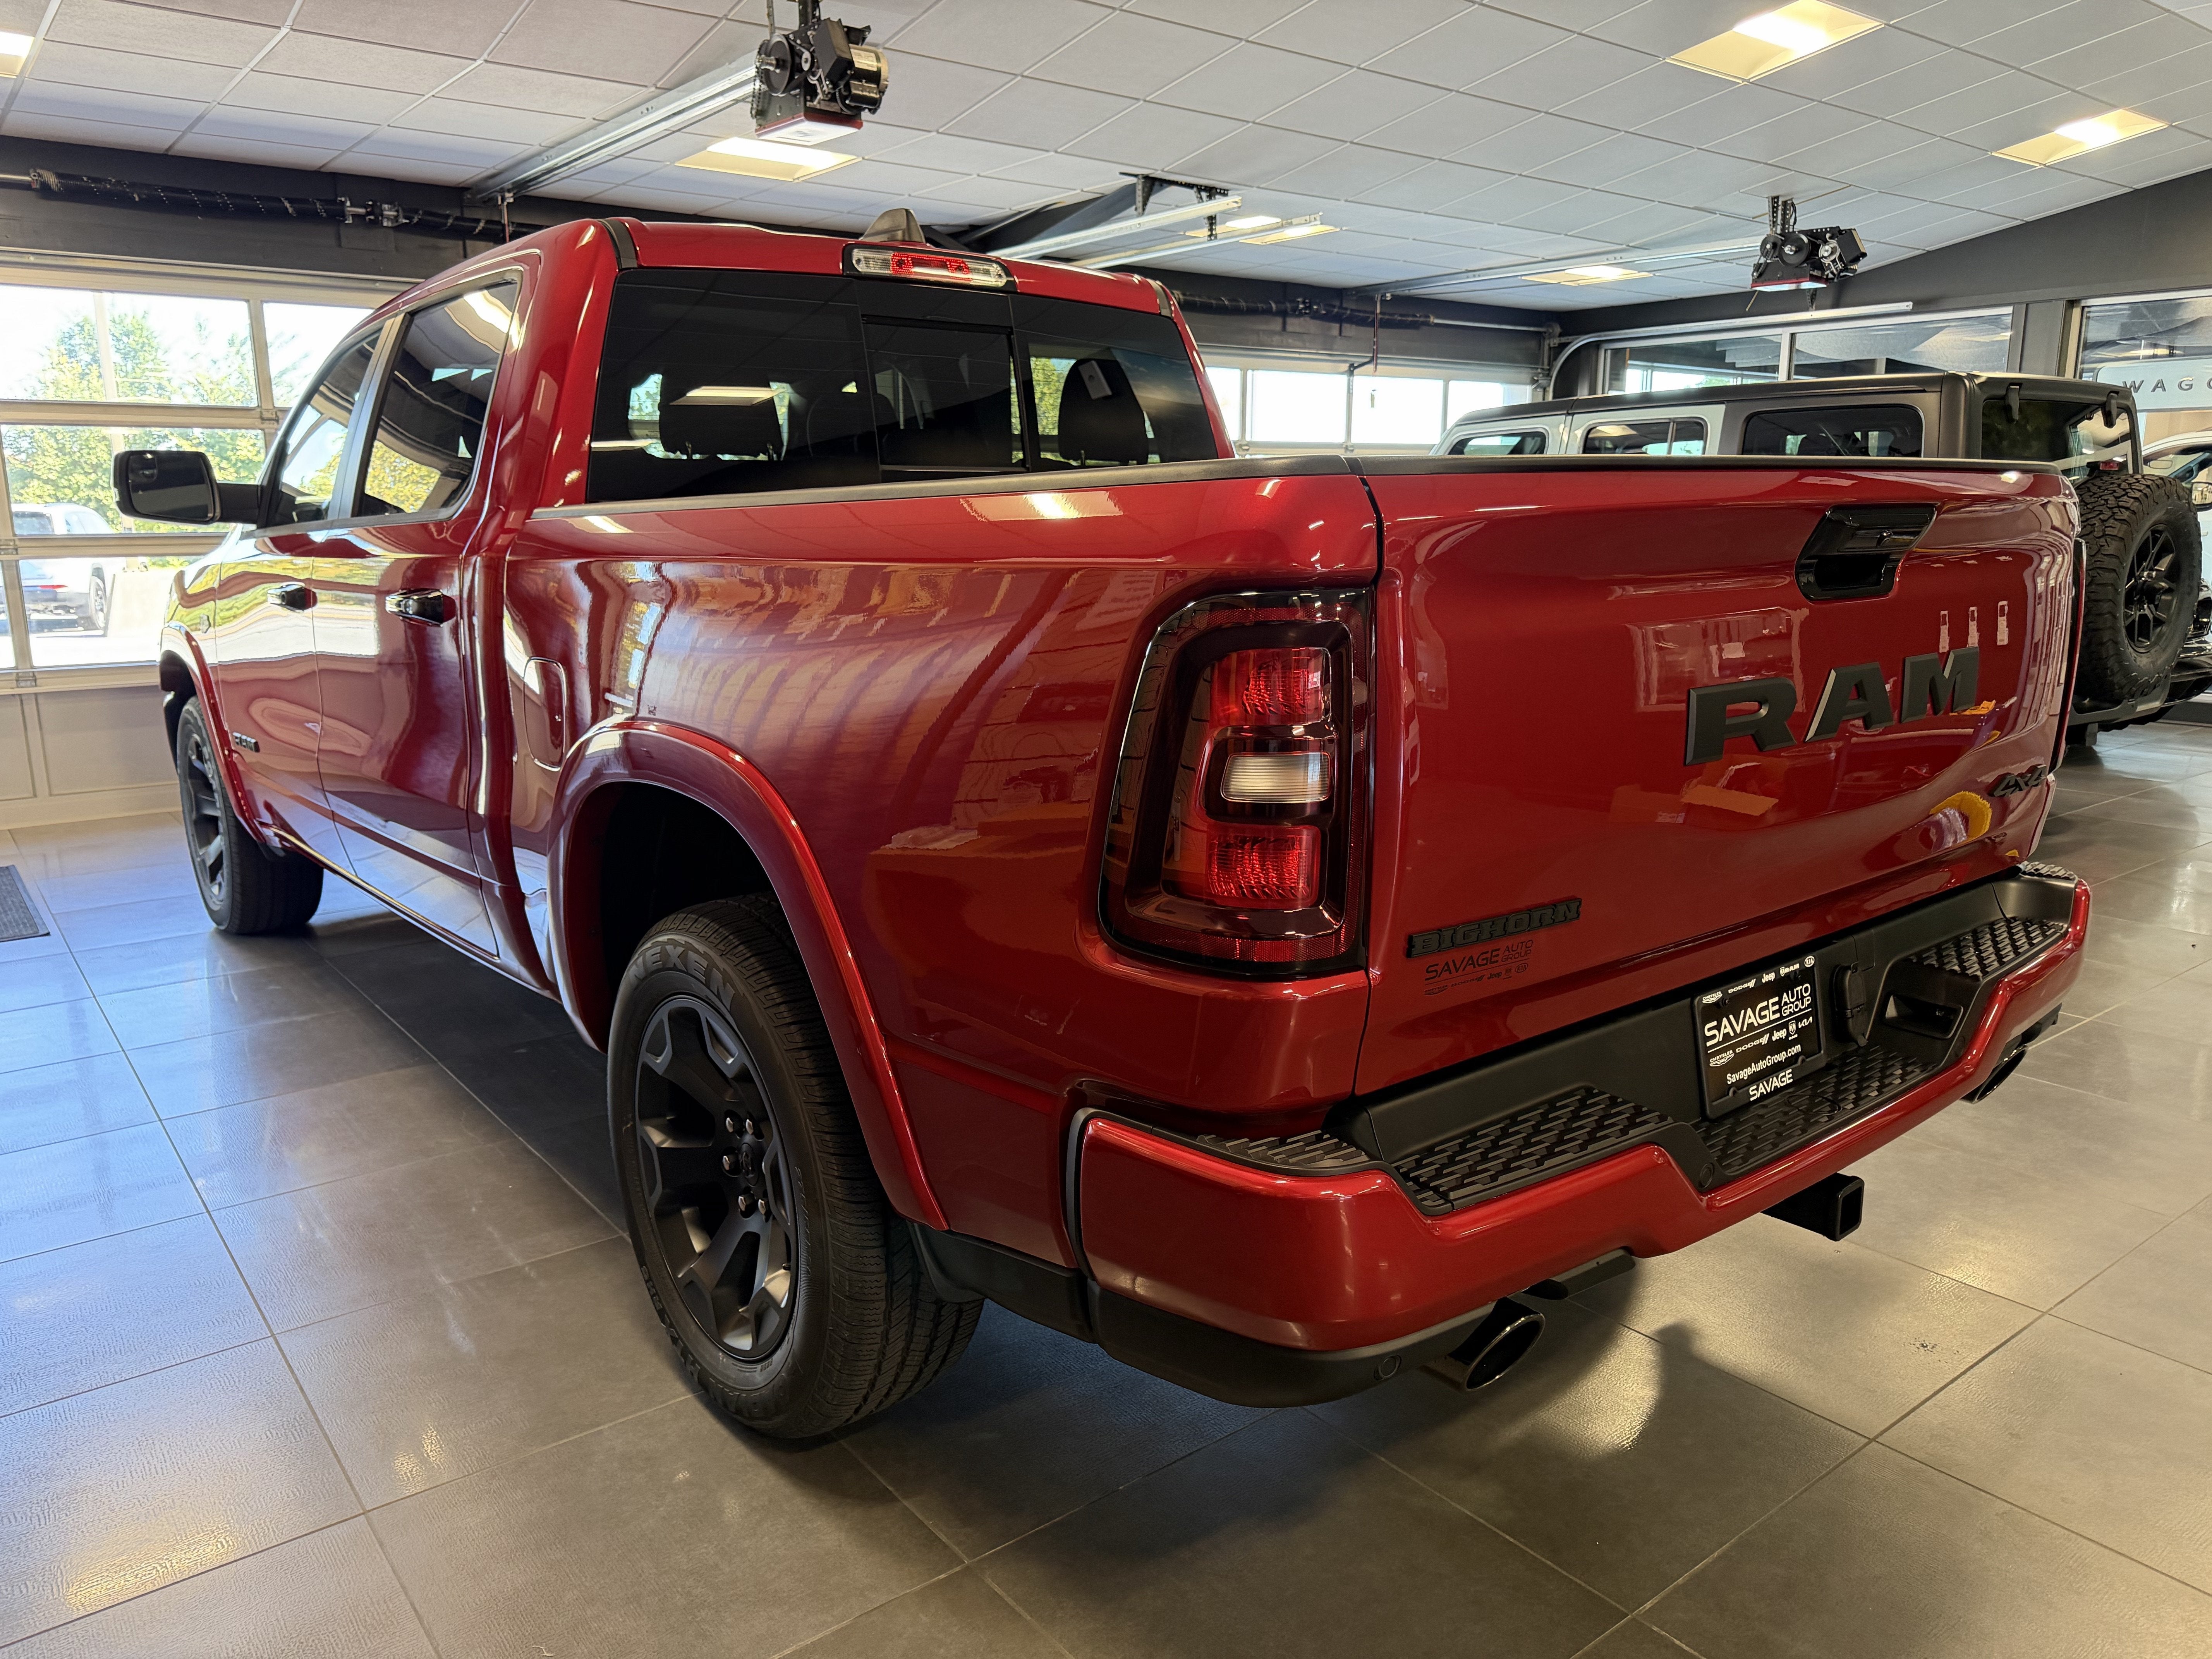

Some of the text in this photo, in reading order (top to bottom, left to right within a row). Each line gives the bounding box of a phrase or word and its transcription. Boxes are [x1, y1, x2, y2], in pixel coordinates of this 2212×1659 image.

[1685, 646, 1980, 766] RAM
[1407, 898, 1582, 958] BIGHORN
[1424, 939, 1533, 981] SAVAGE AUTO
[1501, 949, 1532, 963] GROUP
[1762, 972, 1775, 983] Jeep
[1805, 957, 1814, 966] KIA
[629, 944, 735, 1011] NEXEN
[1487, 971, 1503, 980] Jeep
[1704, 983, 1811, 1047] SAVAGE AUTO
[1782, 996, 1811, 1016] GROUP
[1710, 1050, 1733, 1063] CHRYSLER
[1736, 1036, 1766, 1053] DODGE
[1772, 1029, 1787, 1041] Jeep
[1726, 1044, 1801, 1085] SavageAutoGroup.com
[1749, 1069, 1793, 1101] SAVAGE
